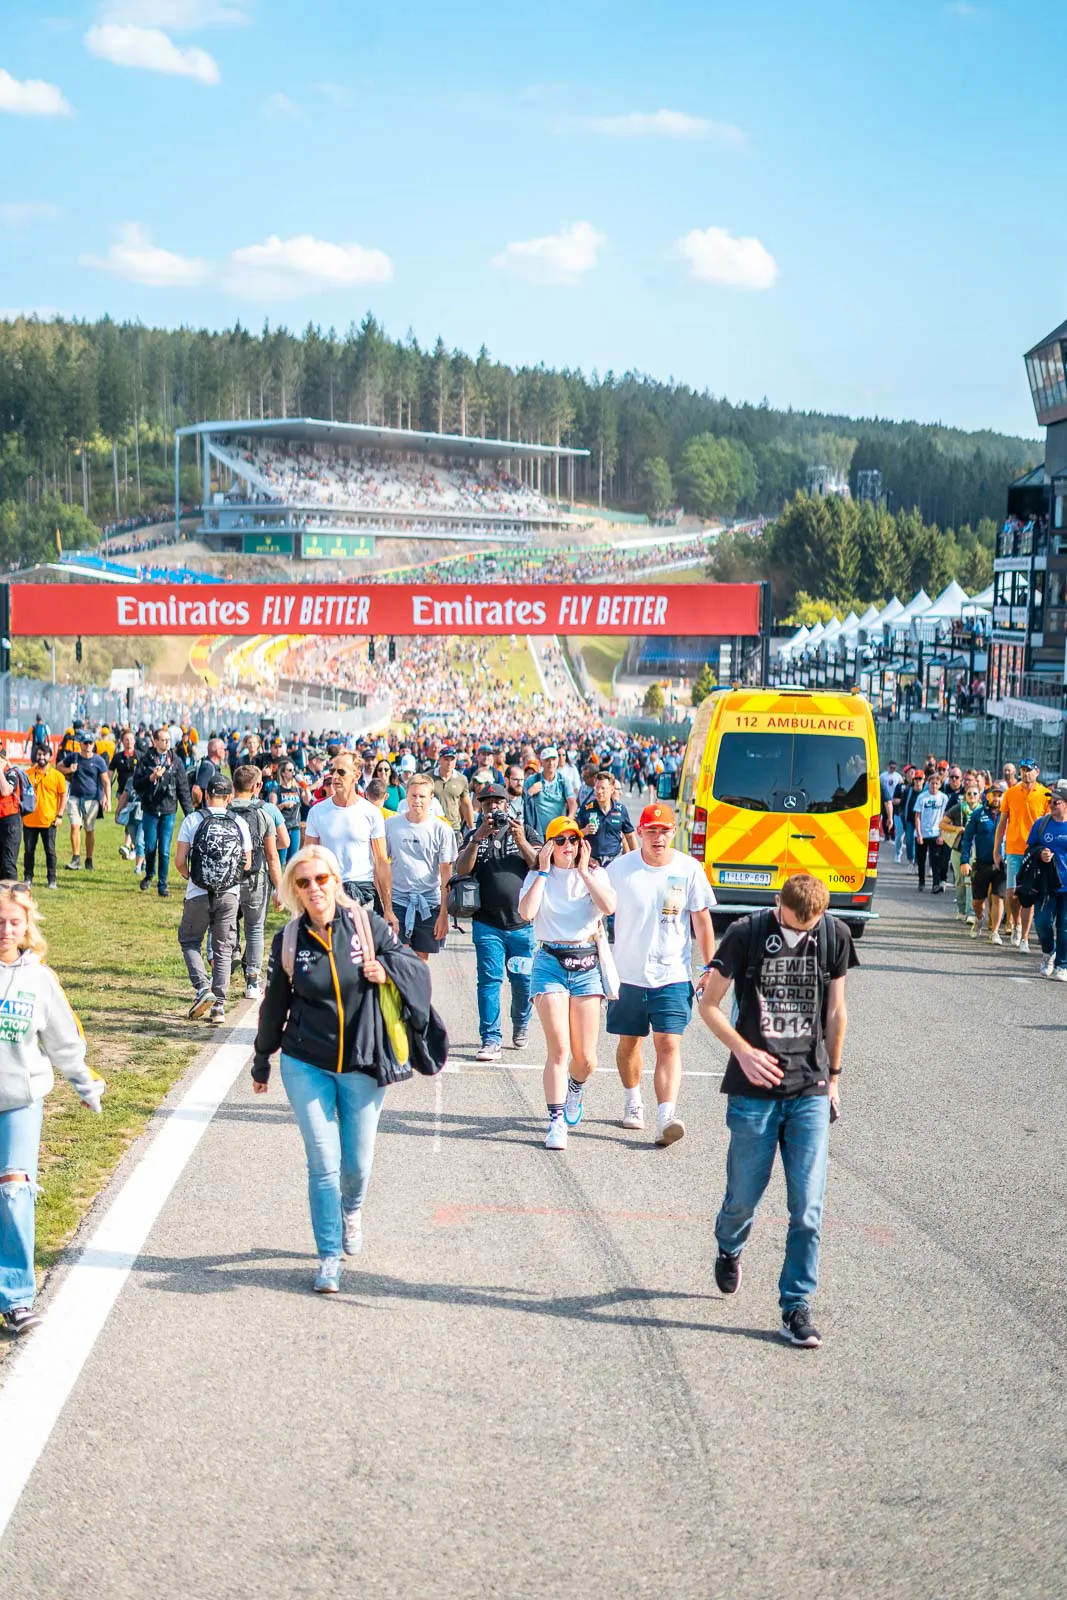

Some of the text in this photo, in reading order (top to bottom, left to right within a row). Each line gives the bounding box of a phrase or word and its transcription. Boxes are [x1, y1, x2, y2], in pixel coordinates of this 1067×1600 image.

[116, 595, 371, 626] Emirates FLY BETTER
[412, 595, 668, 626] Emirates FLY BETTER
[736, 716, 855, 731] 112 AMBULANCE
[829, 874, 856, 884] 10005
[766, 959, 816, 973] LEWIS
[760, 976, 817, 985] HAMILTON
[763, 988, 815, 999] WORLD
[761, 1017, 814, 1033] 2014
